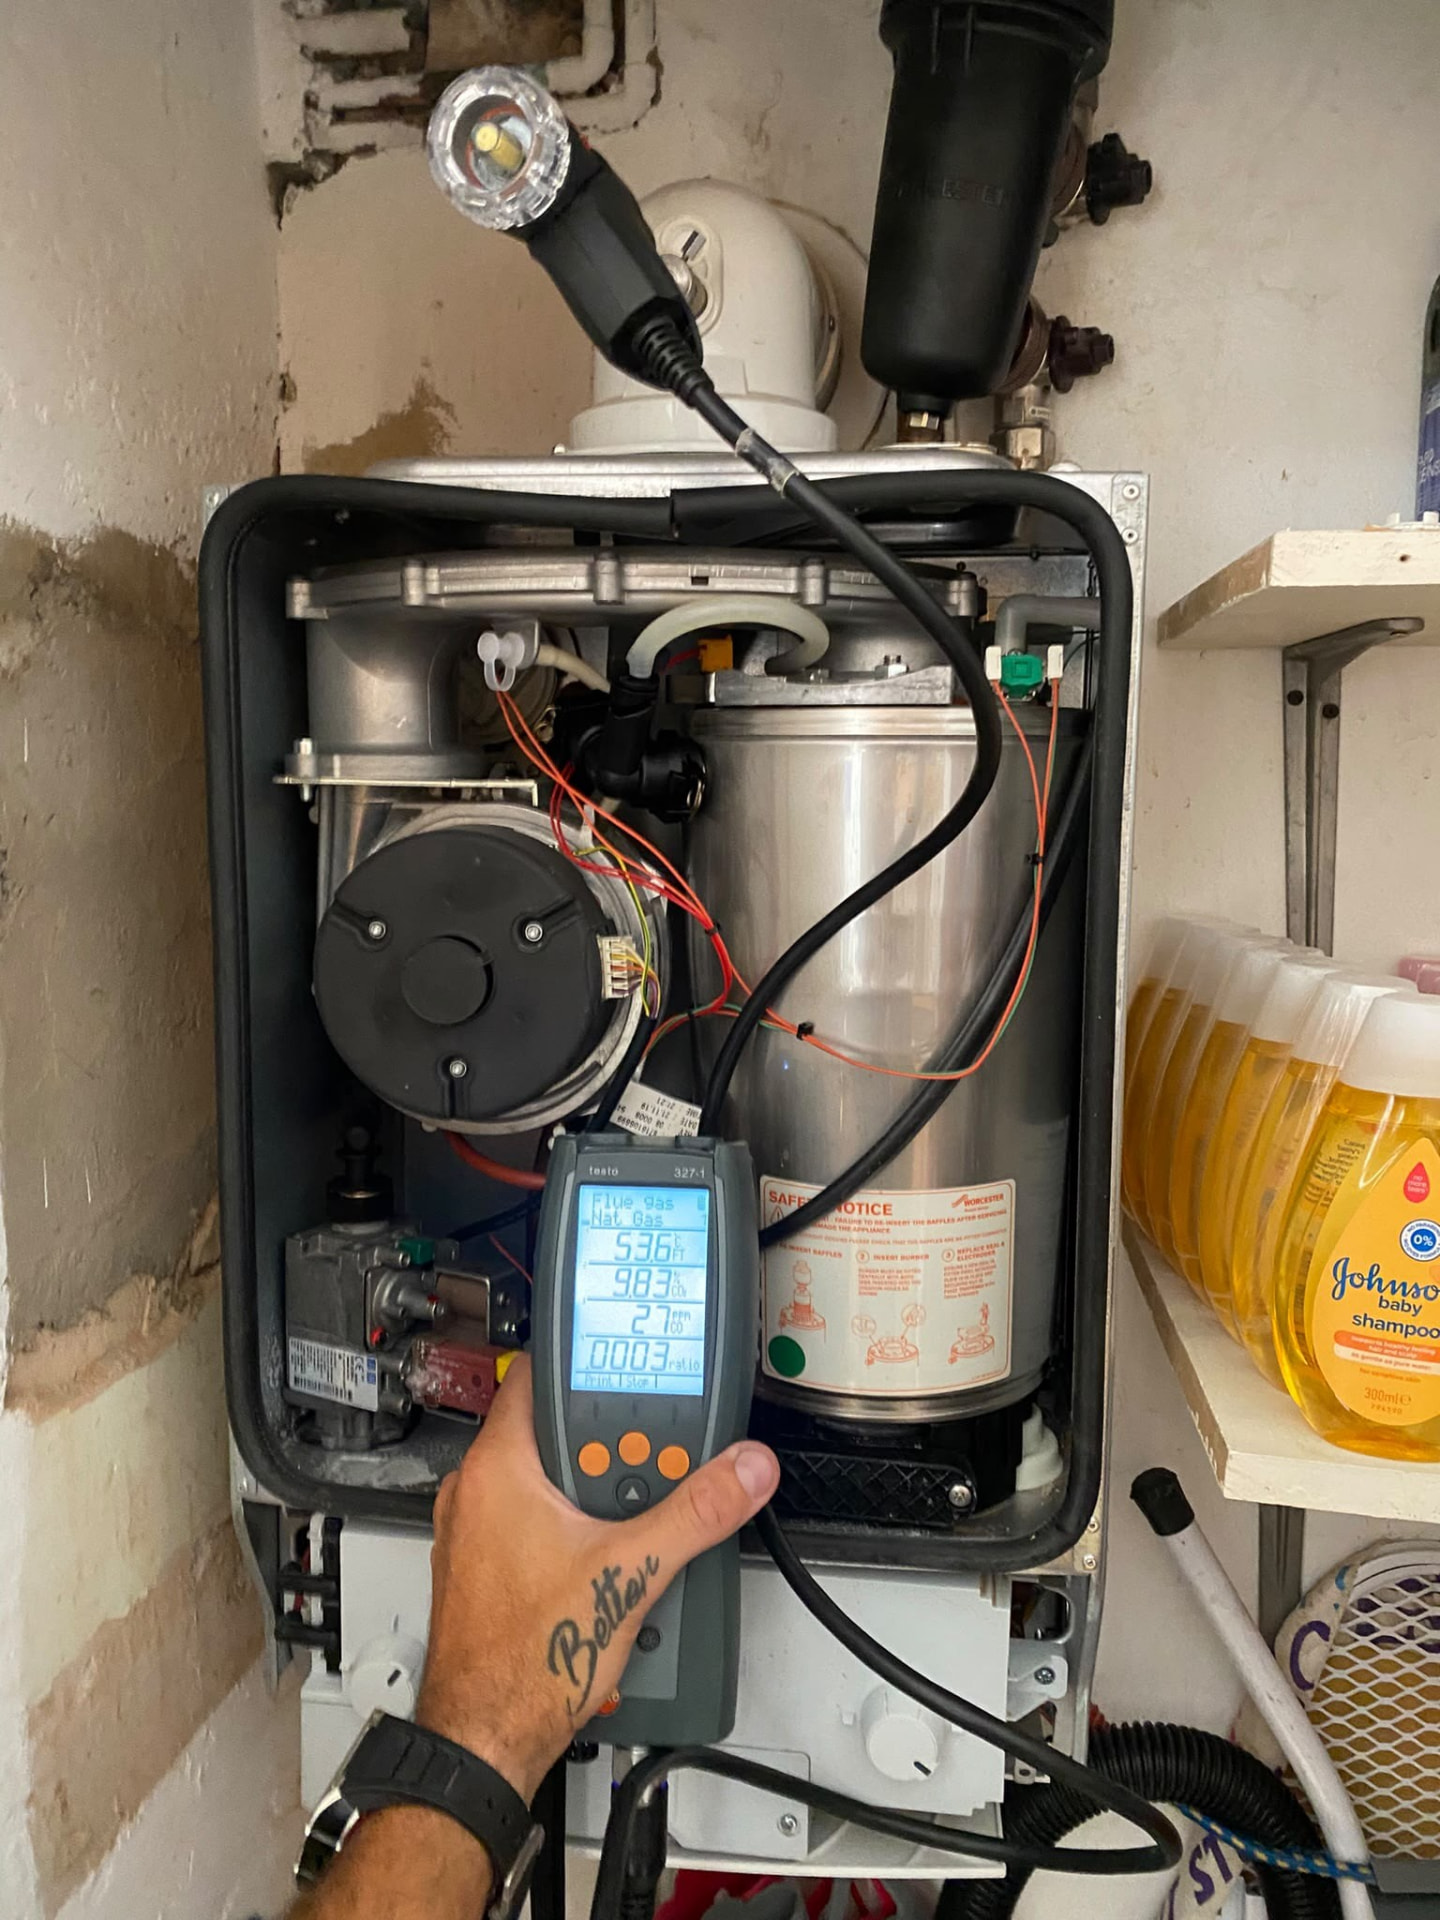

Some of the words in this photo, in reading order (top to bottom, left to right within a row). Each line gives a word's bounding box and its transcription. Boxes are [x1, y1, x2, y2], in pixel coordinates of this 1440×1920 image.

[589, 1166, 619, 1177] testo
[674, 1168, 706, 1179] 327-1
[592, 1193, 634, 1210] Flue
[644, 1196, 674, 1211] gas
[964, 1193, 1004, 1207] WORCESTER
[633, 1211, 664, 1228] Gas
[1413, 1234, 1433, 1247] 0%
[613, 1268, 672, 1299] 9.83
[1379, 1295, 1422, 1317] baby
[631, 1304, 671, 1335] 27
[670, 1321, 683, 1334] CO
[1352, 1313, 1440, 1339] shampoo
[669, 1357, 700, 1371] ratio
[584, 1373, 613, 1388] Print
[1364, 1387, 1399, 1405] 300ml
[547, 1555, 660, 1714] Better
